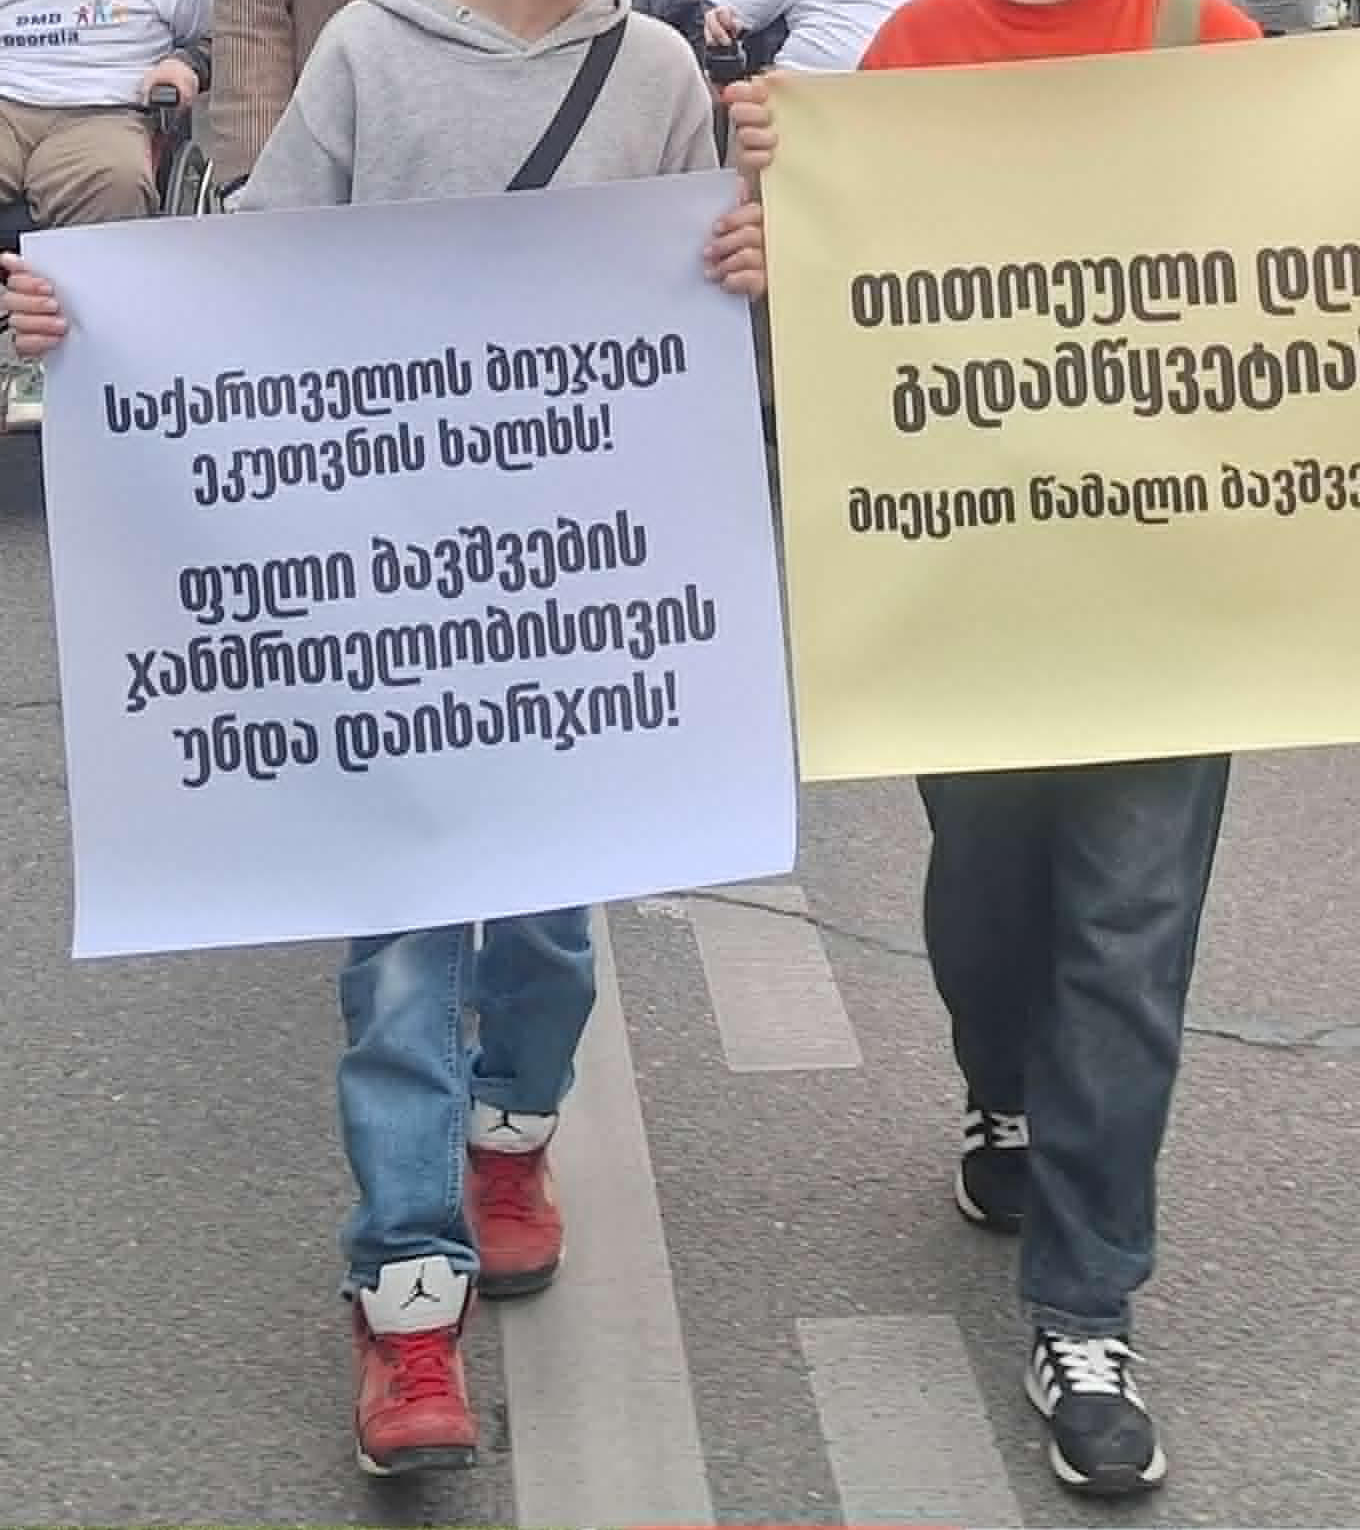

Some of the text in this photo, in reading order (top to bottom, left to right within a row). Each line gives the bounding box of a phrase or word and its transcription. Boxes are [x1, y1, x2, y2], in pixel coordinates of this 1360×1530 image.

[850, 249, 1238, 327] თითოეული
[103, 333, 687, 438] საქართველოს ბიუჯეტი
[193, 404, 615, 506] ეკუთვნის ხალხს!
[848, 486, 1016, 539] მიეცით
[1030, 472, 1209, 524] წამალი
[177, 510, 648, 623] ფული ბავშვების
[126, 584, 716, 714] ჯანმრთელობისთვის
[172, 671, 679, 788] უნდა დაიხარჯოს!
